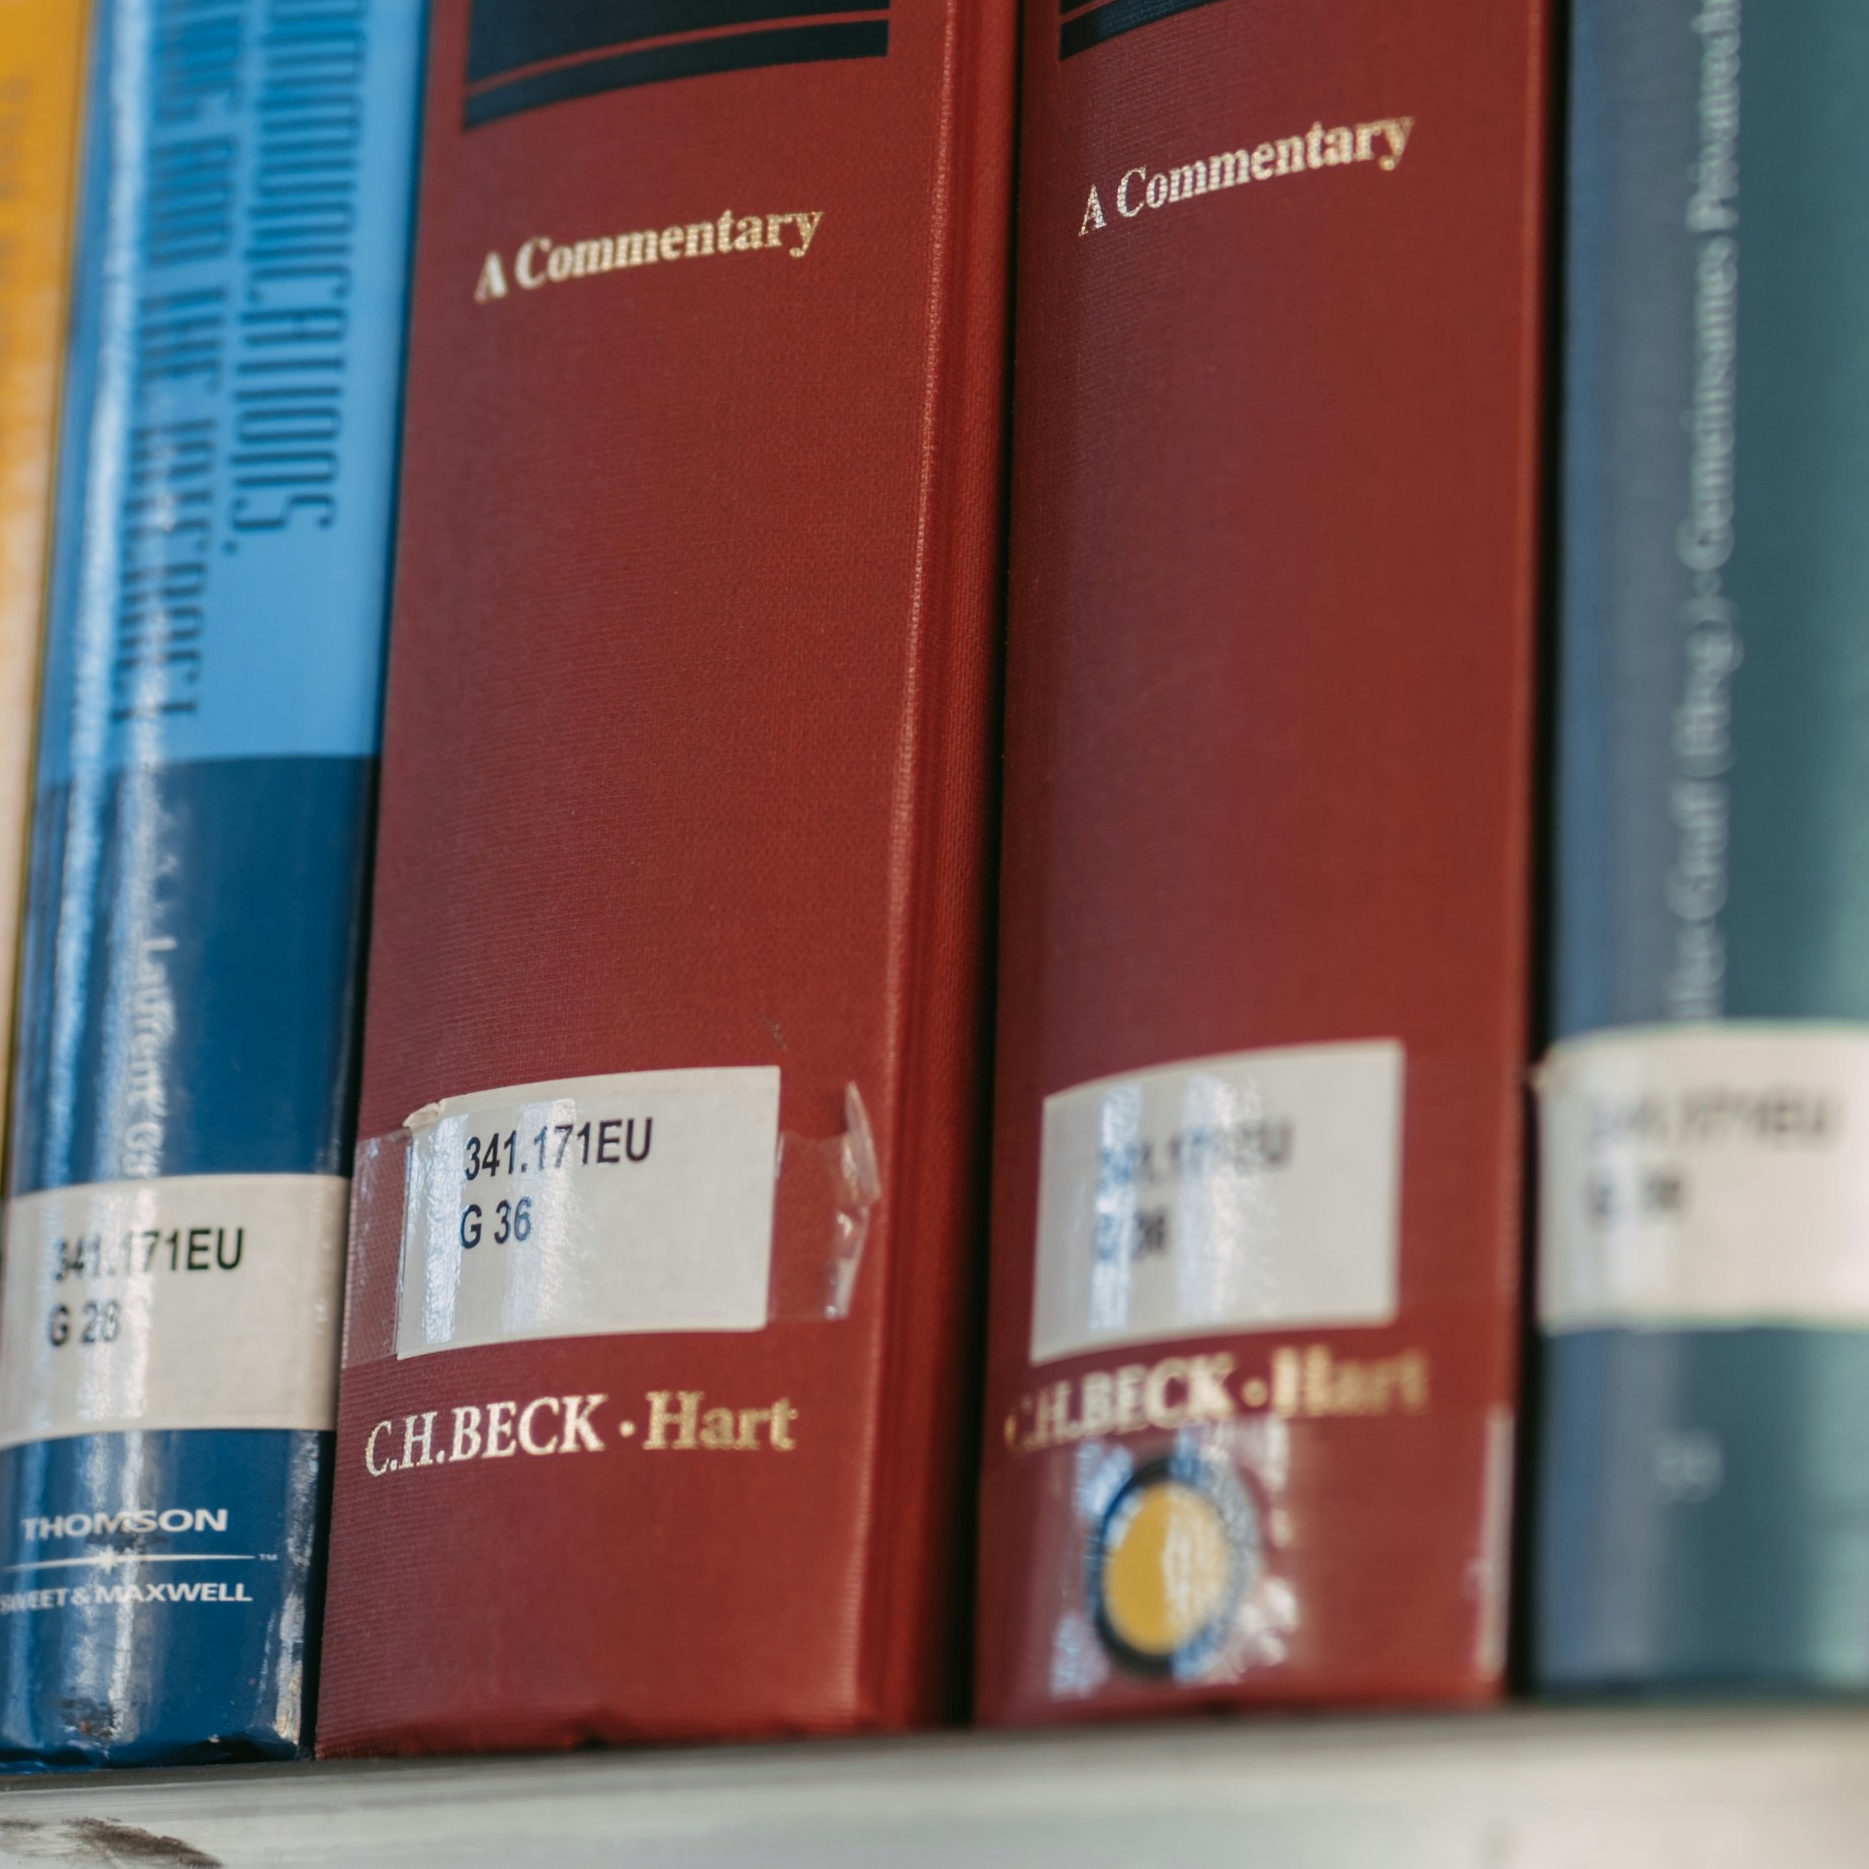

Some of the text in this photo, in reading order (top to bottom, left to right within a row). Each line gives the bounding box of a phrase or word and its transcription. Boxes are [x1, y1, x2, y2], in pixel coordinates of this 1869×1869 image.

[1078, 115, 1415, 236] A Commentary
[474, 208, 825, 304] A Commentary
[464, 1116, 656, 1182] 341.171EU
[458, 1195, 533, 1250] G 36
[52, 1226, 245, 1282] 341.171EU
[48, 1298, 120, 1347] G 28
[1271, 1343, 1428, 1417] Hart
[365, 1390, 799, 1477] C.H.BECK Hart
[21, 1508, 228, 1542] THOMSON
[94, 1582, 253, 1606] MAXWELL
